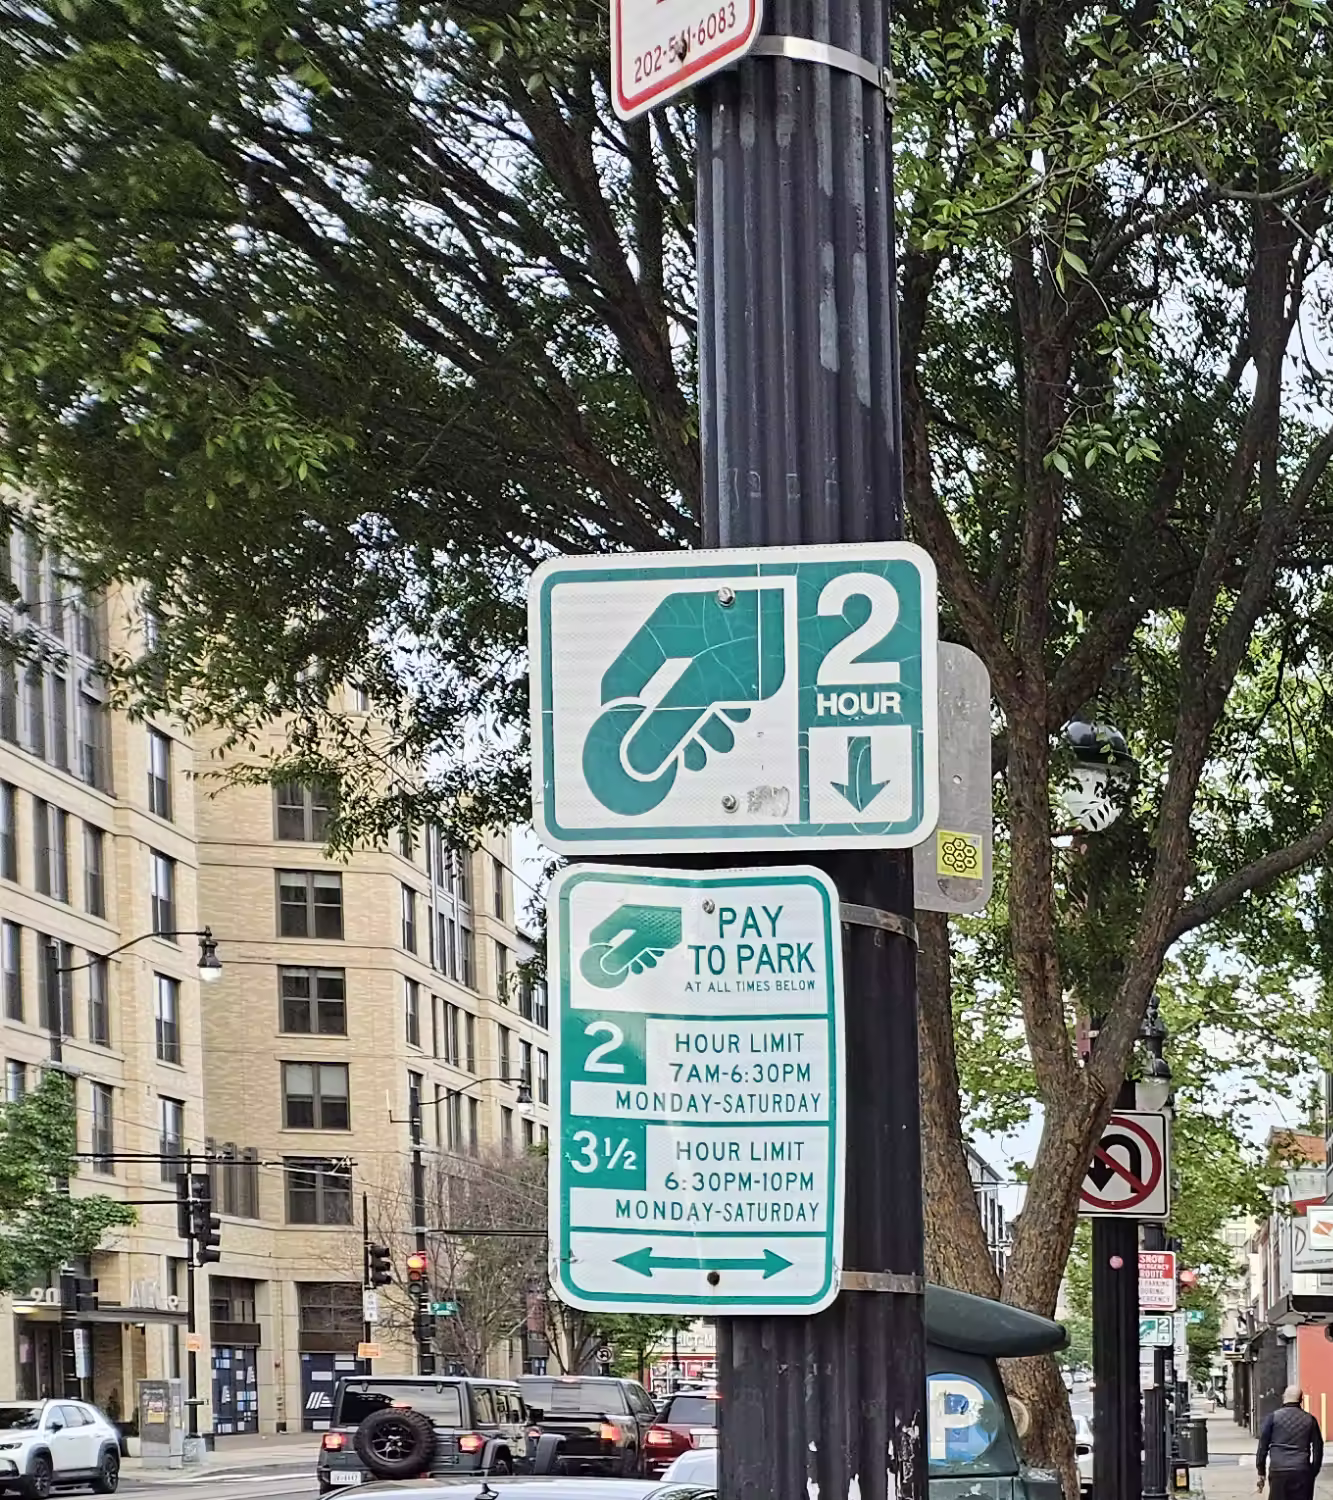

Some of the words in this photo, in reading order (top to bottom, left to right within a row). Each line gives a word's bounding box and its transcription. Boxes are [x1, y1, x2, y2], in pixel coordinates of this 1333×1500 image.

[816, 572, 900, 686] 2
[817, 691, 902, 717] HOUR
[718, 905, 784, 939] PAY
[690, 943, 726, 976] TO
[737, 942, 816, 975] PARK
[684, 981, 702, 993] AT
[708, 981, 732, 993] ALL
[735, 980, 771, 993] TIMES
[775, 979, 816, 993] BELOW
[583, 1020, 625, 1074] 2
[675, 1033, 741, 1054] HOUR
[750, 1033, 805, 1054] LIMIT
[670, 1062, 812, 1085] 7AM-6:30PM
[615, 1091, 822, 1114] MONDAY-SATURDAY
[676, 1141, 741, 1161] HOUR
[750, 1141, 805, 1161] LIMIT
[664, 1171, 814, 1192] 6:30PM-10PM
[615, 1199, 820, 1222] MONDAY-SATURDAY
[1158, 1318, 1169, 1330] 2
[928, 1379, 984, 1460] P
